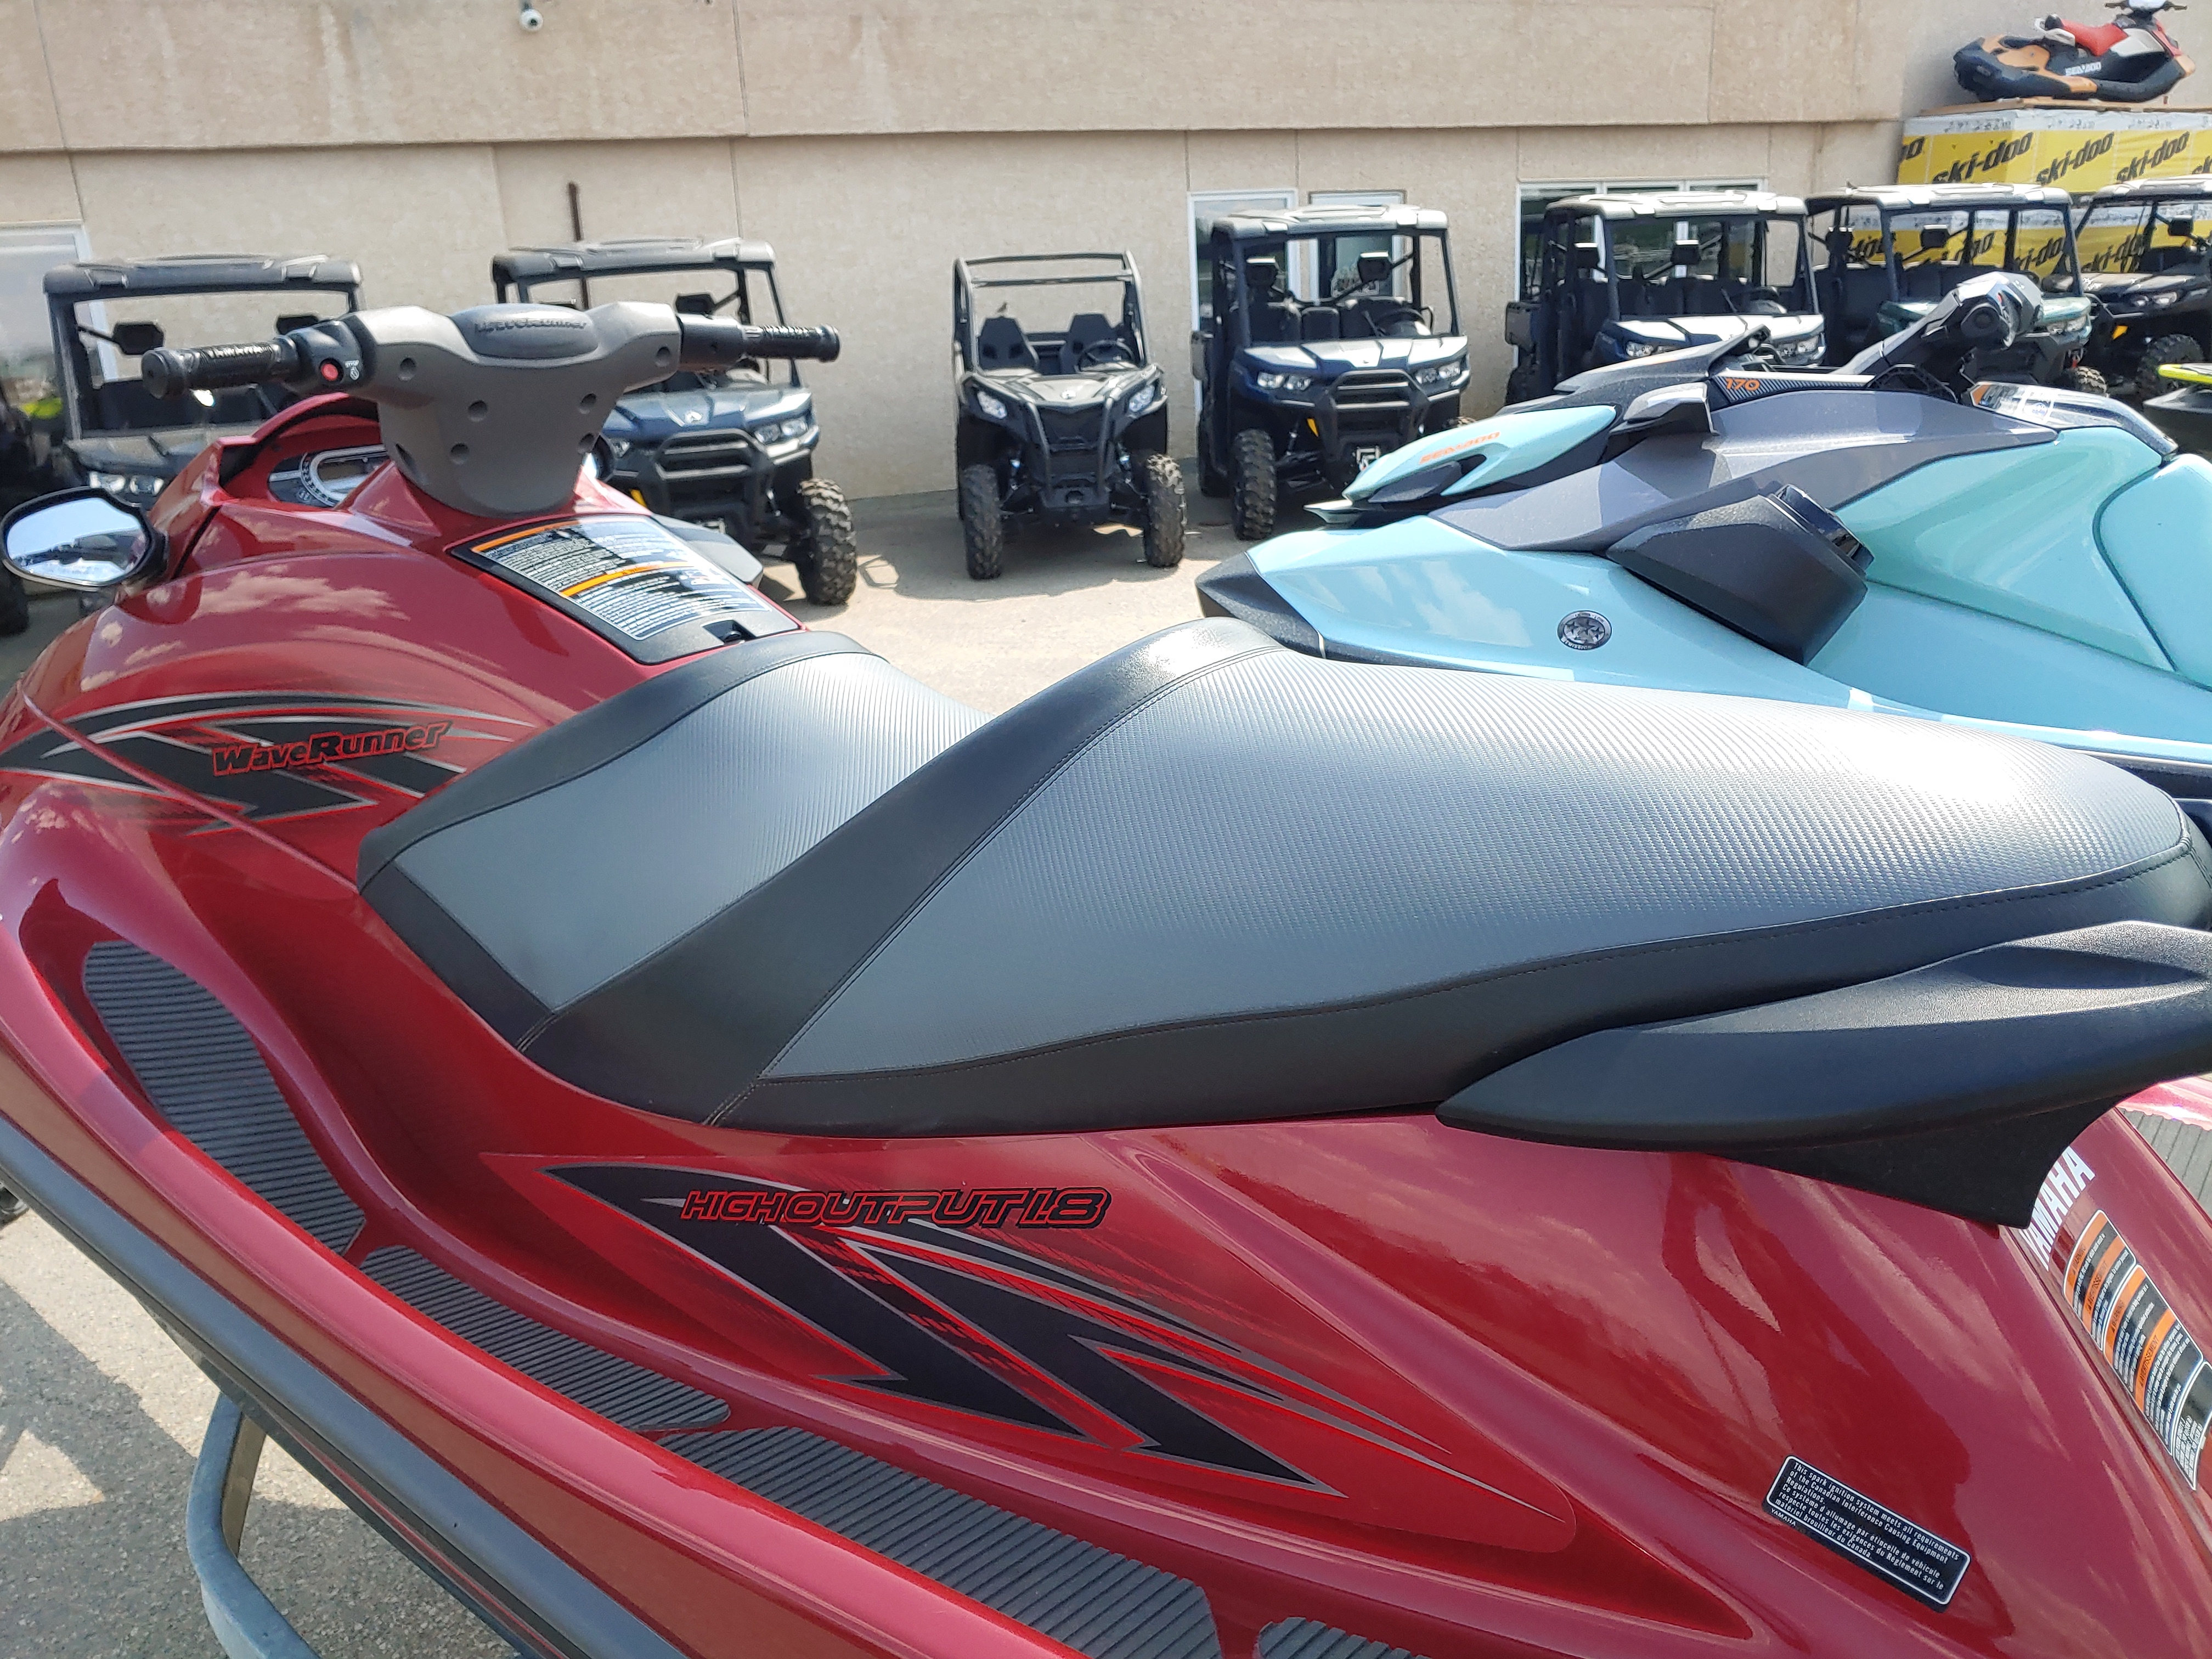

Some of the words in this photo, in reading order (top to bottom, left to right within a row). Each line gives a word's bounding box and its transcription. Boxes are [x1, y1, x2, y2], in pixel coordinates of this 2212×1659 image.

[1725, 377, 1760, 391] 170
[212, 721, 452, 776] WaveRunner
[2019, 1146, 2096, 1272] YAMAHA
[1771, 1508, 1796, 1526] YAMAHA
[1779, 1492, 1807, 1511] respecte
[1808, 1508, 1830, 1525] toutes
[1830, 1520, 1841, 1531] les
[1841, 1528, 1875, 1550] exigences
[1876, 1548, 1885, 1556] du
[1923, 1575, 1936, 1585] sur
[1936, 1581, 1944, 1590] le
[1782, 1483, 1791, 1493] Ce
[1855, 1527, 1869, 1537] par
[1901, 1552, 1910, 1561] de
[1790, 1470, 1798, 1479] of
[1798, 1474, 1810, 1485] the
[1810, 1481, 1841, 1503] Canadian
[1841, 1499, 1883, 1527] Interference
[1884, 1523, 1911, 1544] Causing
[1912, 1539, 1948, 1564] Equipment
[1793, 1462, 1808, 1475] This
[1808, 1472, 1827, 1486] spark
[1828, 1482, 1855, 1502] ignition
[1855, 1499, 1880, 1516] system
[1881, 1513, 1902, 1528] meets
[1903, 1526, 1914, 1534] all
[1914, 1532, 1960, 1560] requirements
[1803, 1514, 1836, 1537] brouilleur
[1837, 1534, 1846, 1543] du
